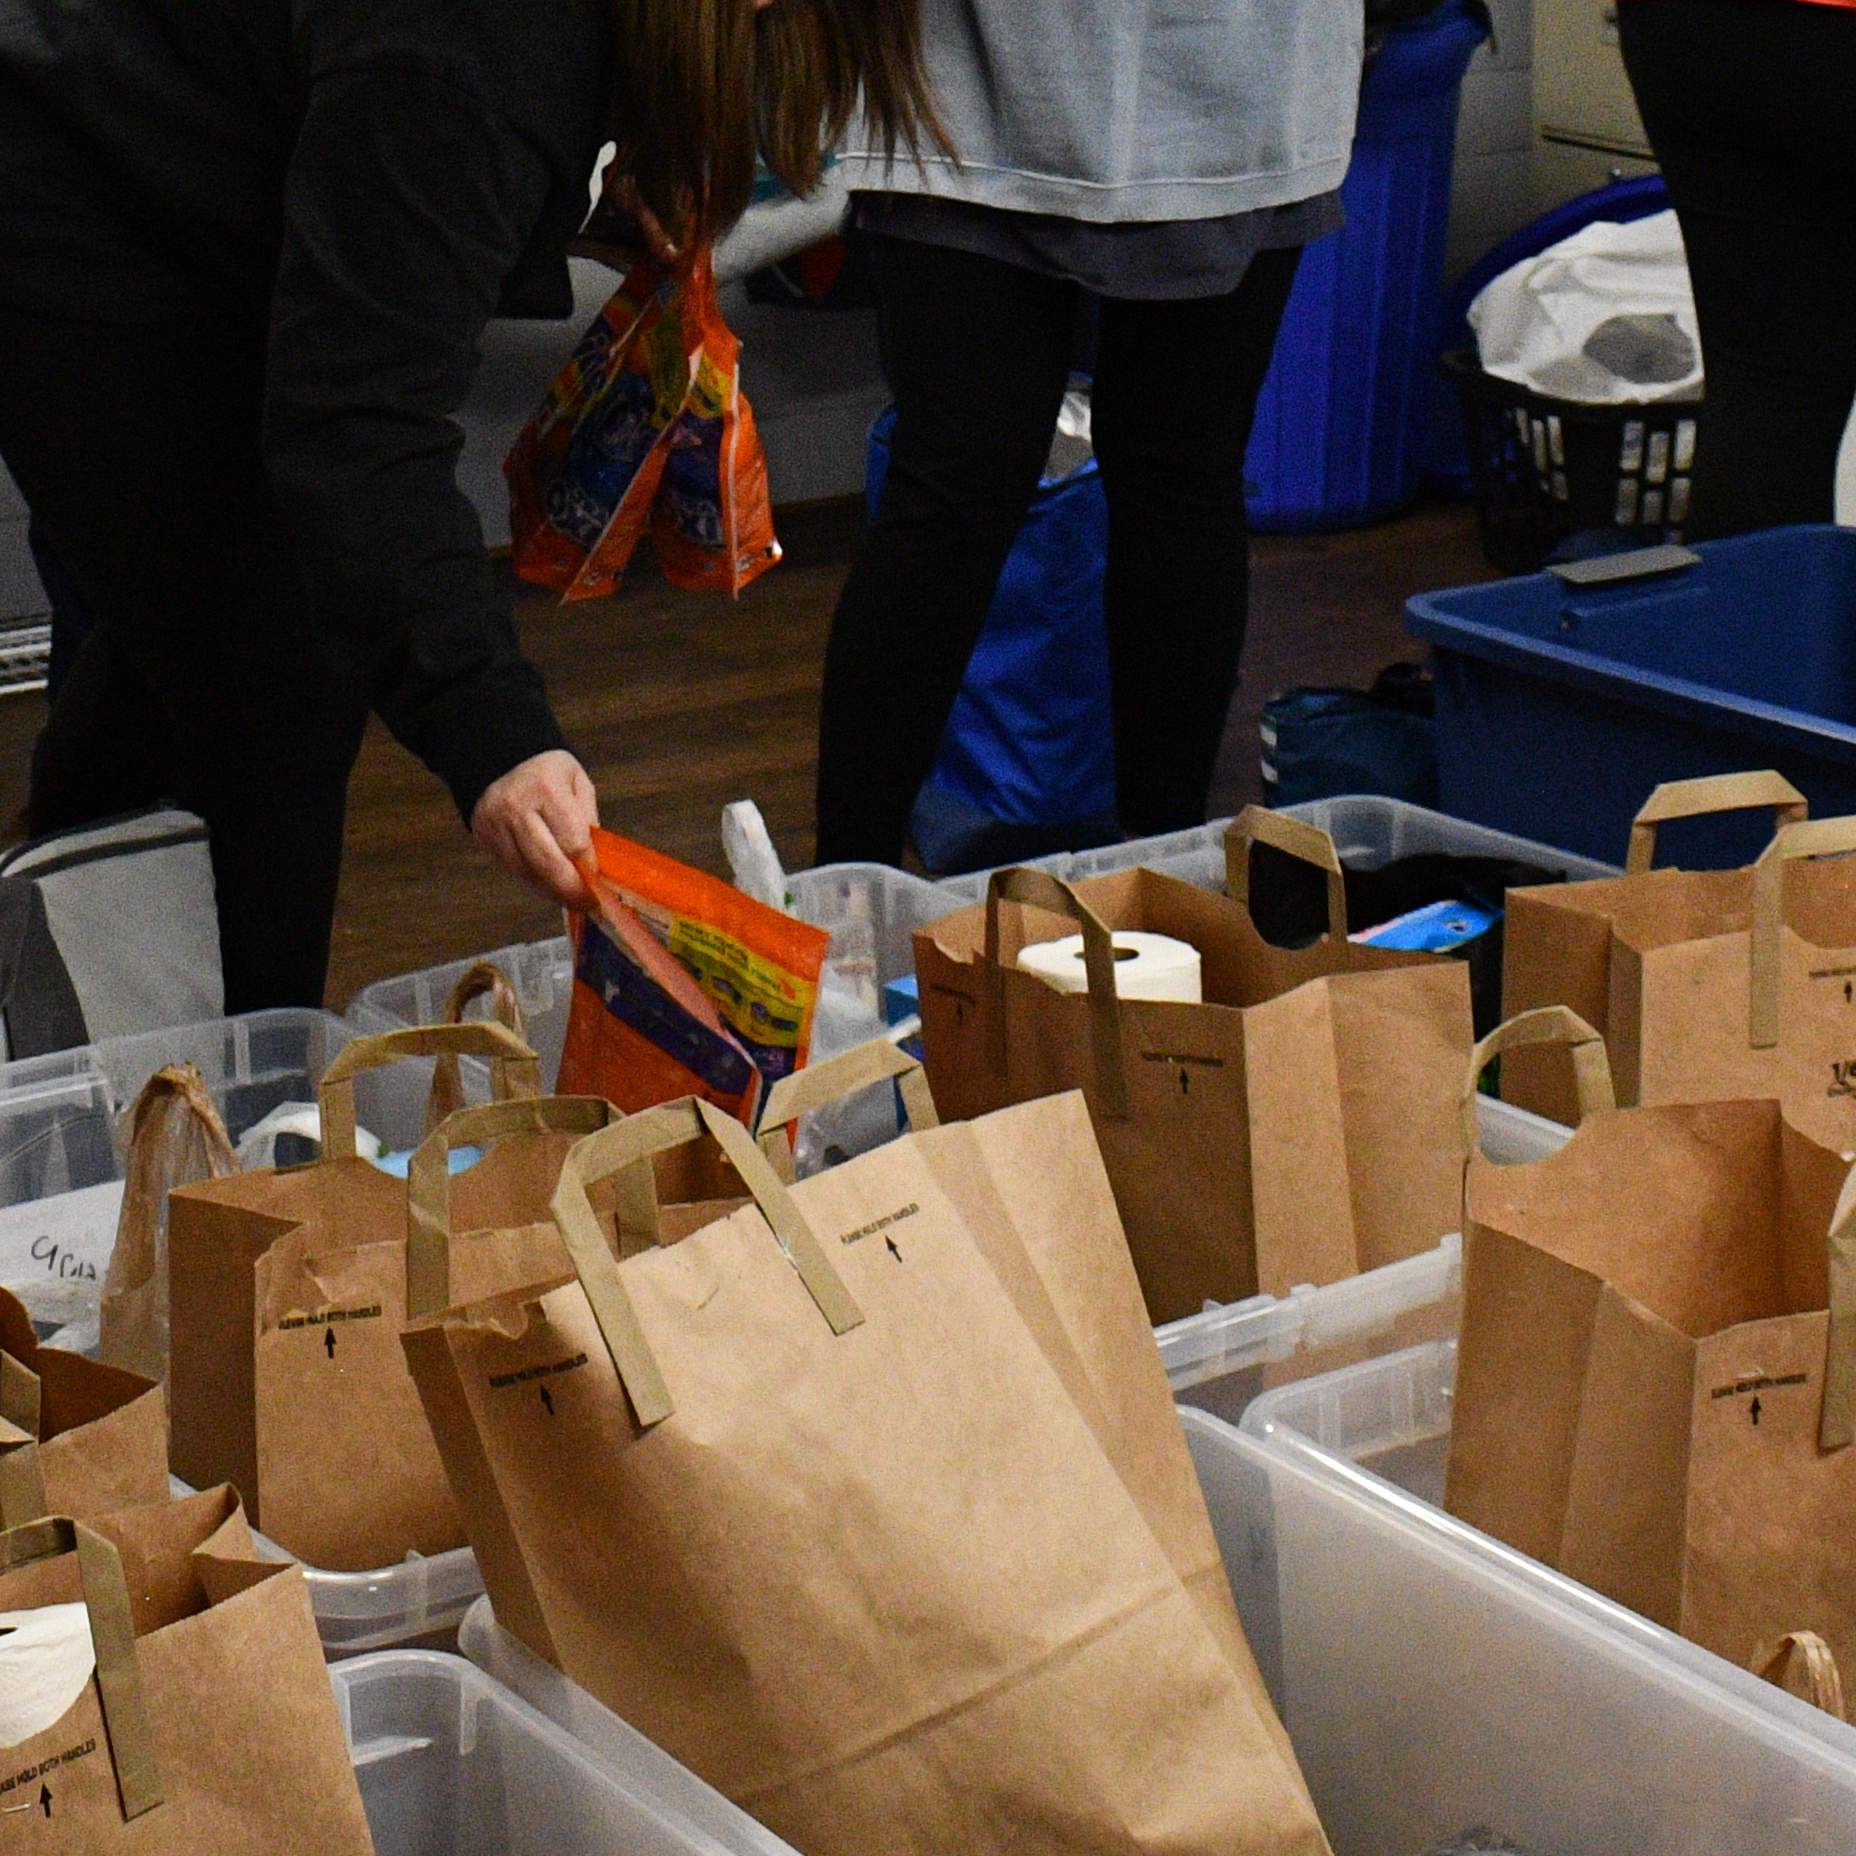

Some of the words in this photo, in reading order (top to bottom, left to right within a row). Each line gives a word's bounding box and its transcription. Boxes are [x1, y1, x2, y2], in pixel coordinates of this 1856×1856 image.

[16, 1765, 38, 1786] HOLD
[38, 1755, 61, 1776] BOTH
[61, 1737, 97, 1762] HANDLES
